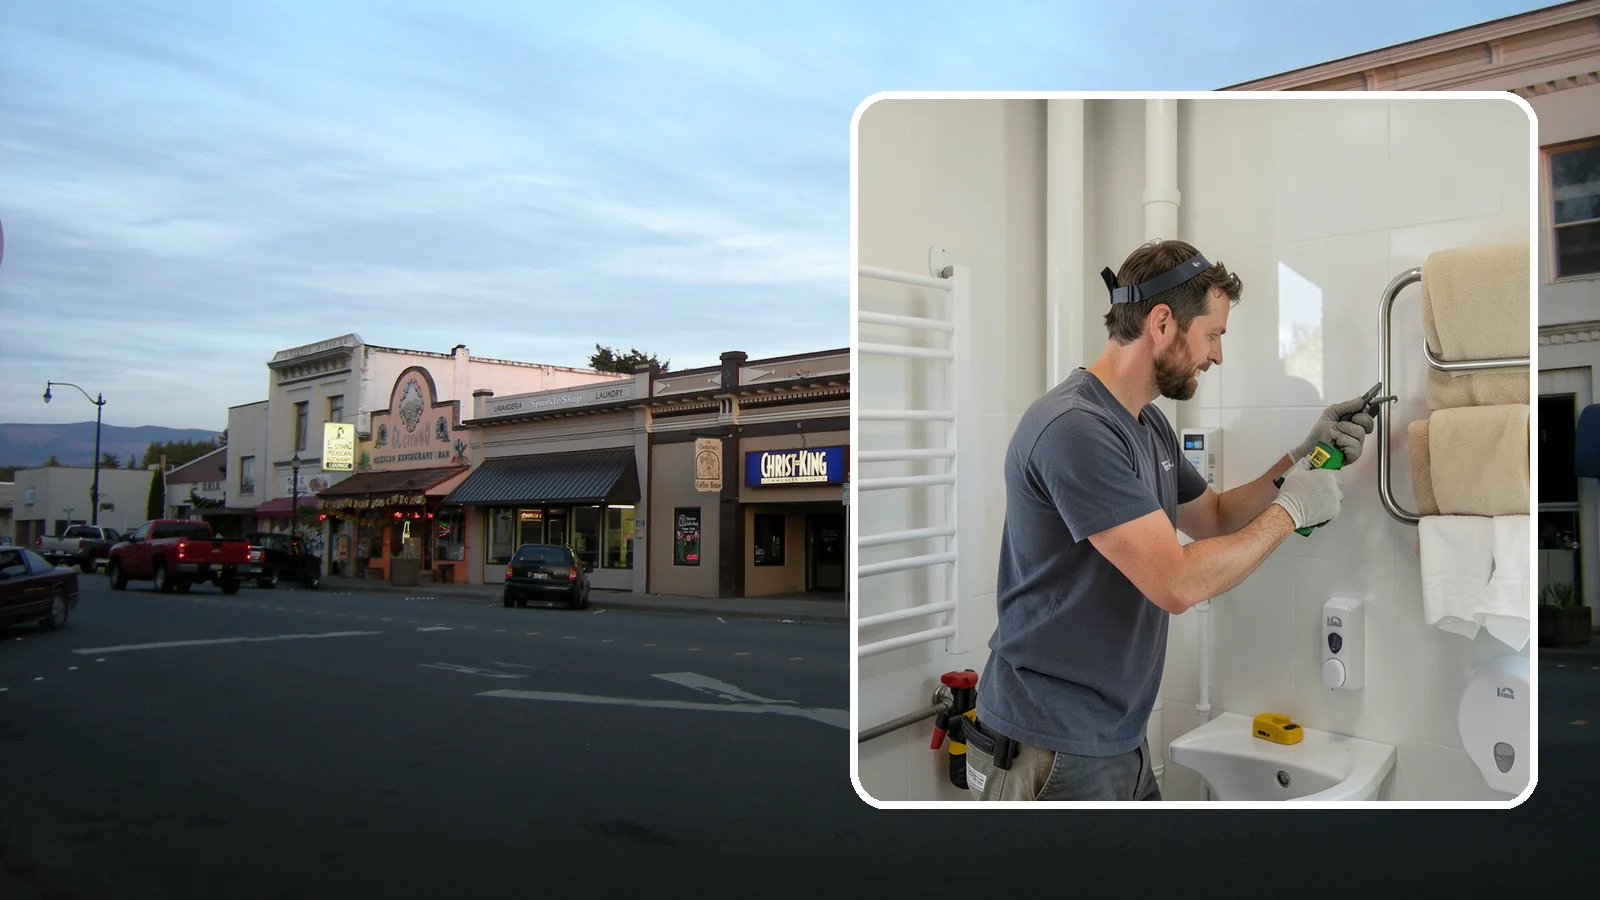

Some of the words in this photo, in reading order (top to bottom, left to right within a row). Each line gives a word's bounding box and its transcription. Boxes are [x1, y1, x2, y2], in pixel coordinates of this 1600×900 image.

[494, 402, 523, 412] LAVANDERIA
[530, 396, 560, 409] Sparkle
[561, 394, 582, 406] Shop
[595, 389, 624, 399] LAUNDRY
[397, 451, 433, 462] RESTAURANT
[437, 450, 450, 459] BAR
[761, 452, 797, 477] CHRIST
[798, 450, 828, 476] KING
